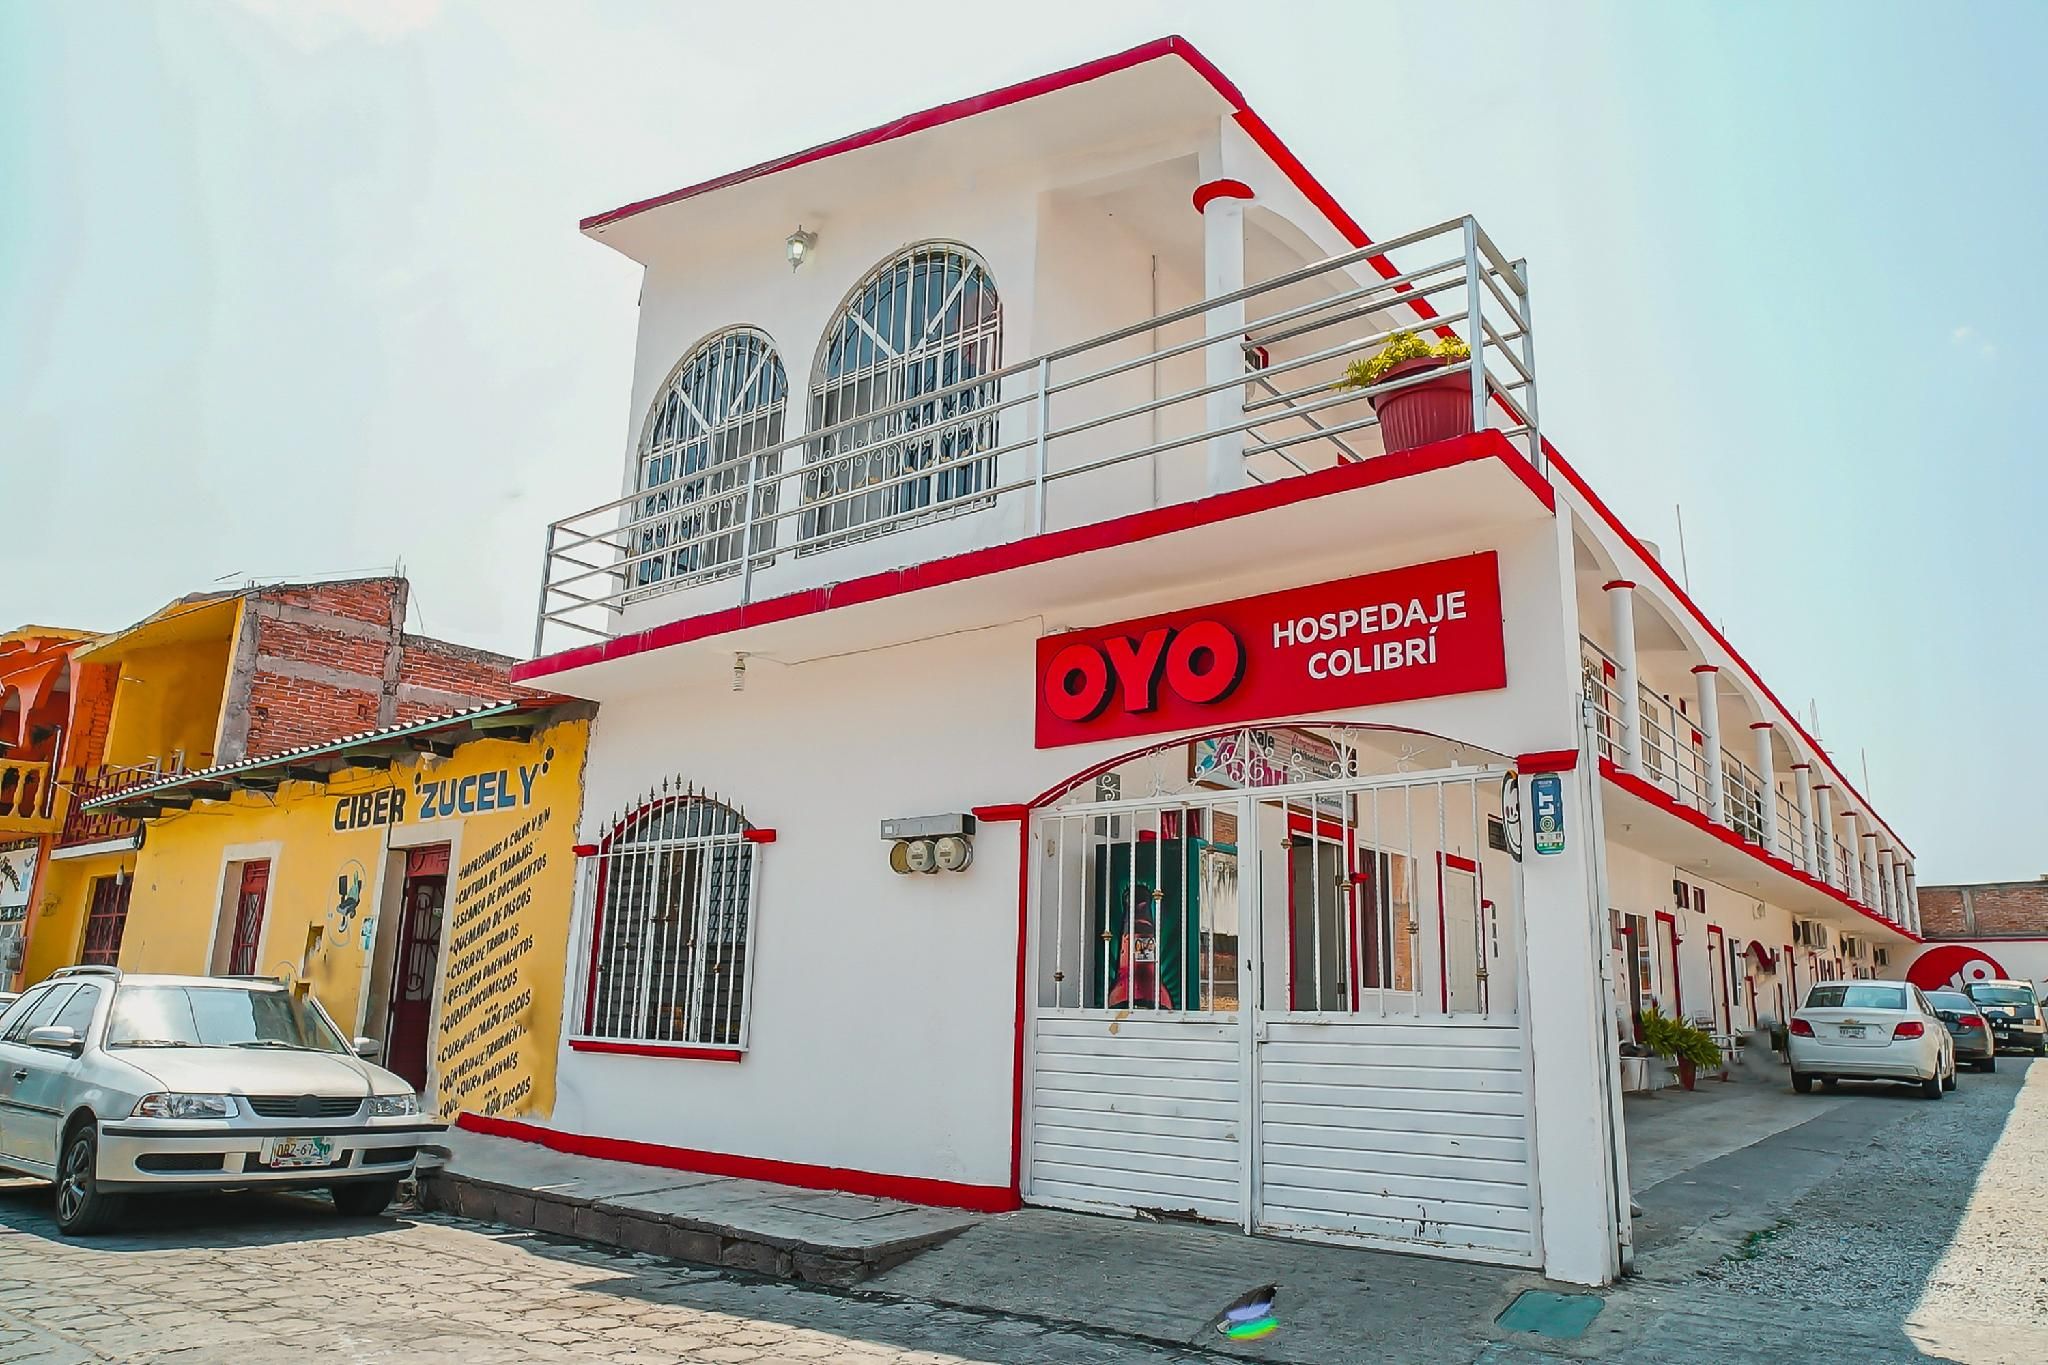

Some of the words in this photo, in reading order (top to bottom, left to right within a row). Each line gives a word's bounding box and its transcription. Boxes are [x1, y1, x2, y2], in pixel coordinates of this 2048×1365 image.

[1273, 590, 1467, 649] HOSPEDAJE
[1044, 620, 1246, 722] OYO
[1308, 625, 1438, 680] COLIBRÍ
[334, 787, 406, 831] CIBER
[486, 889, 497, 907] DE
[497, 853, 547, 902] DOCUMENTOS
[453, 916, 491, 956] QUEMADO
[492, 906, 502, 928] DE
[503, 887, 531, 920] DISCOS
